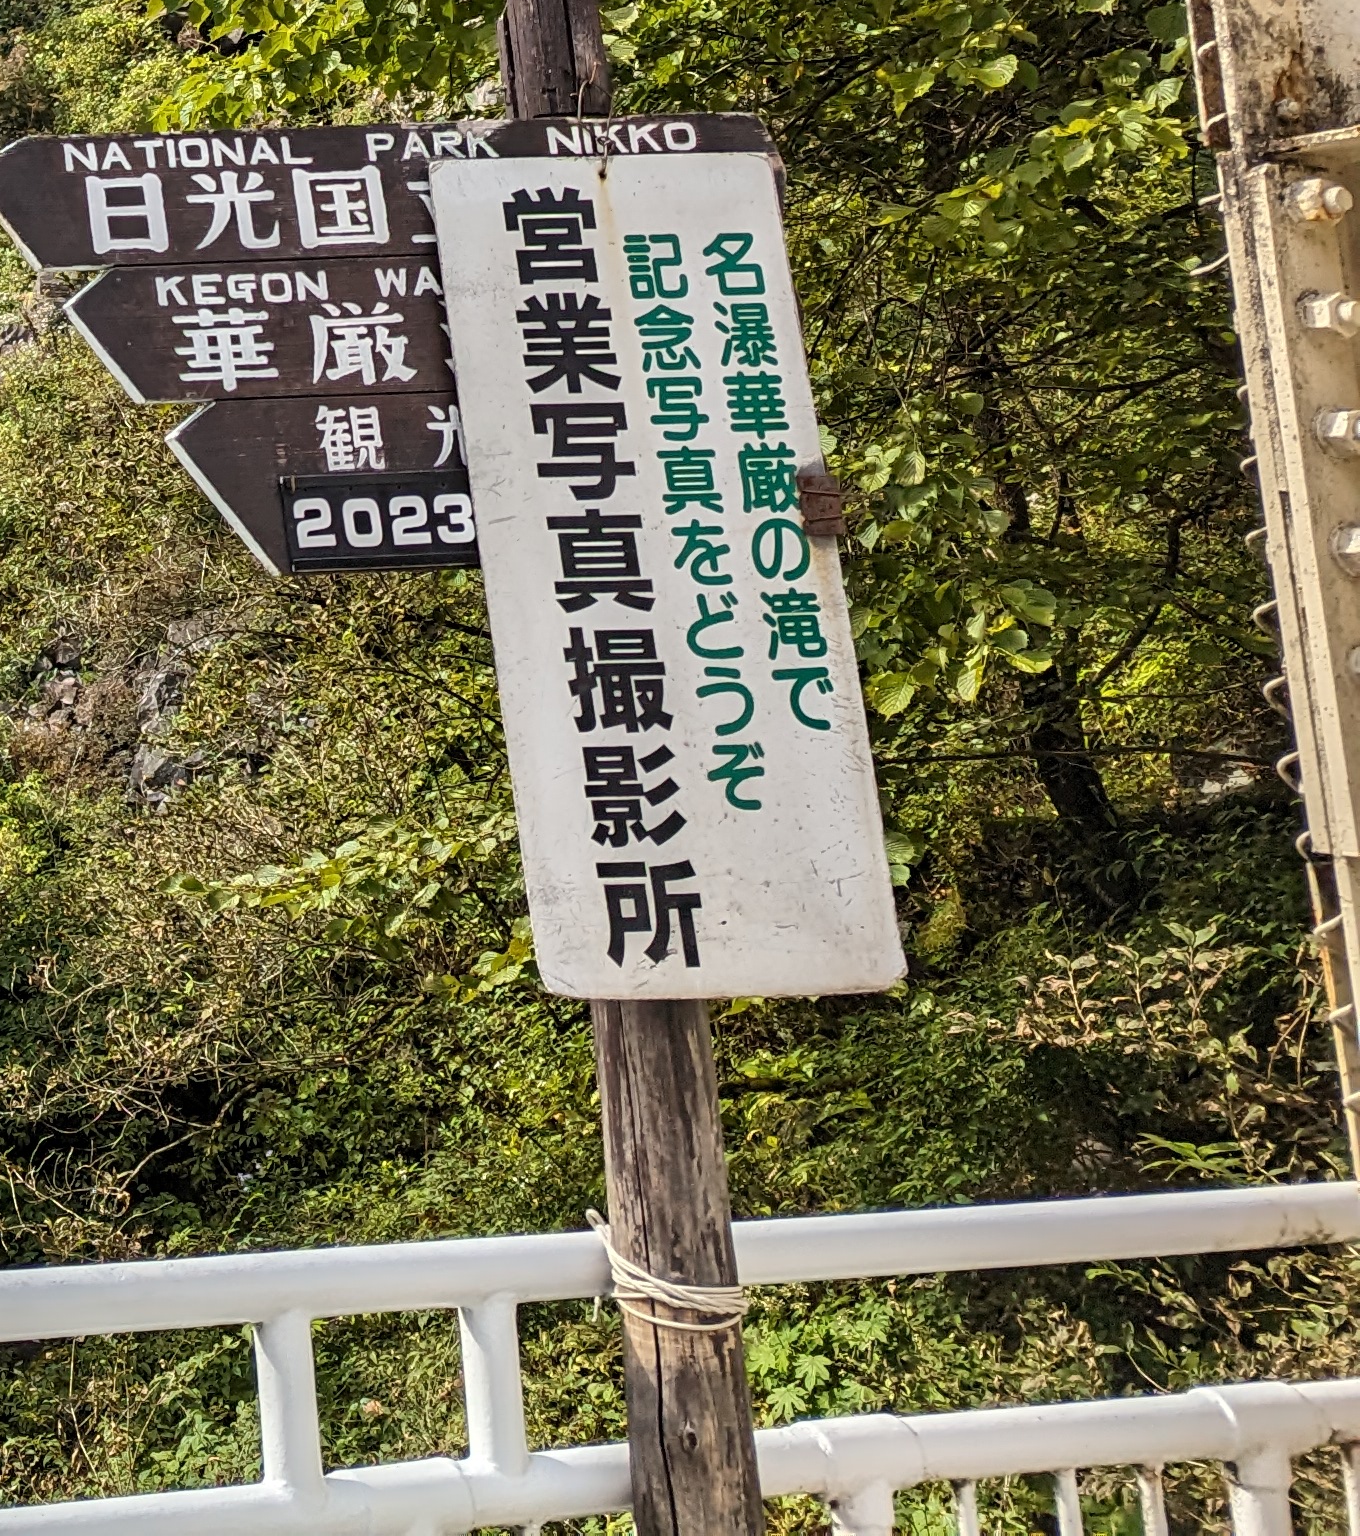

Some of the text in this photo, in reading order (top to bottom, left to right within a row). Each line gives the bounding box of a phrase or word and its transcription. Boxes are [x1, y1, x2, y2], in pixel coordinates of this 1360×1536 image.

[64, 121, 698, 172] NATIONAL PARK NIKKO
[156, 270, 328, 306] KEGON
[172, 301, 457, 392] 華厳
[291, 491, 476, 549] 2023
[622, 233, 766, 812] 記念写真をどうぞ
[702, 232, 834, 731] 名瀑華厳の滝で
[502, 186, 702, 969] 営業写真撮影所
